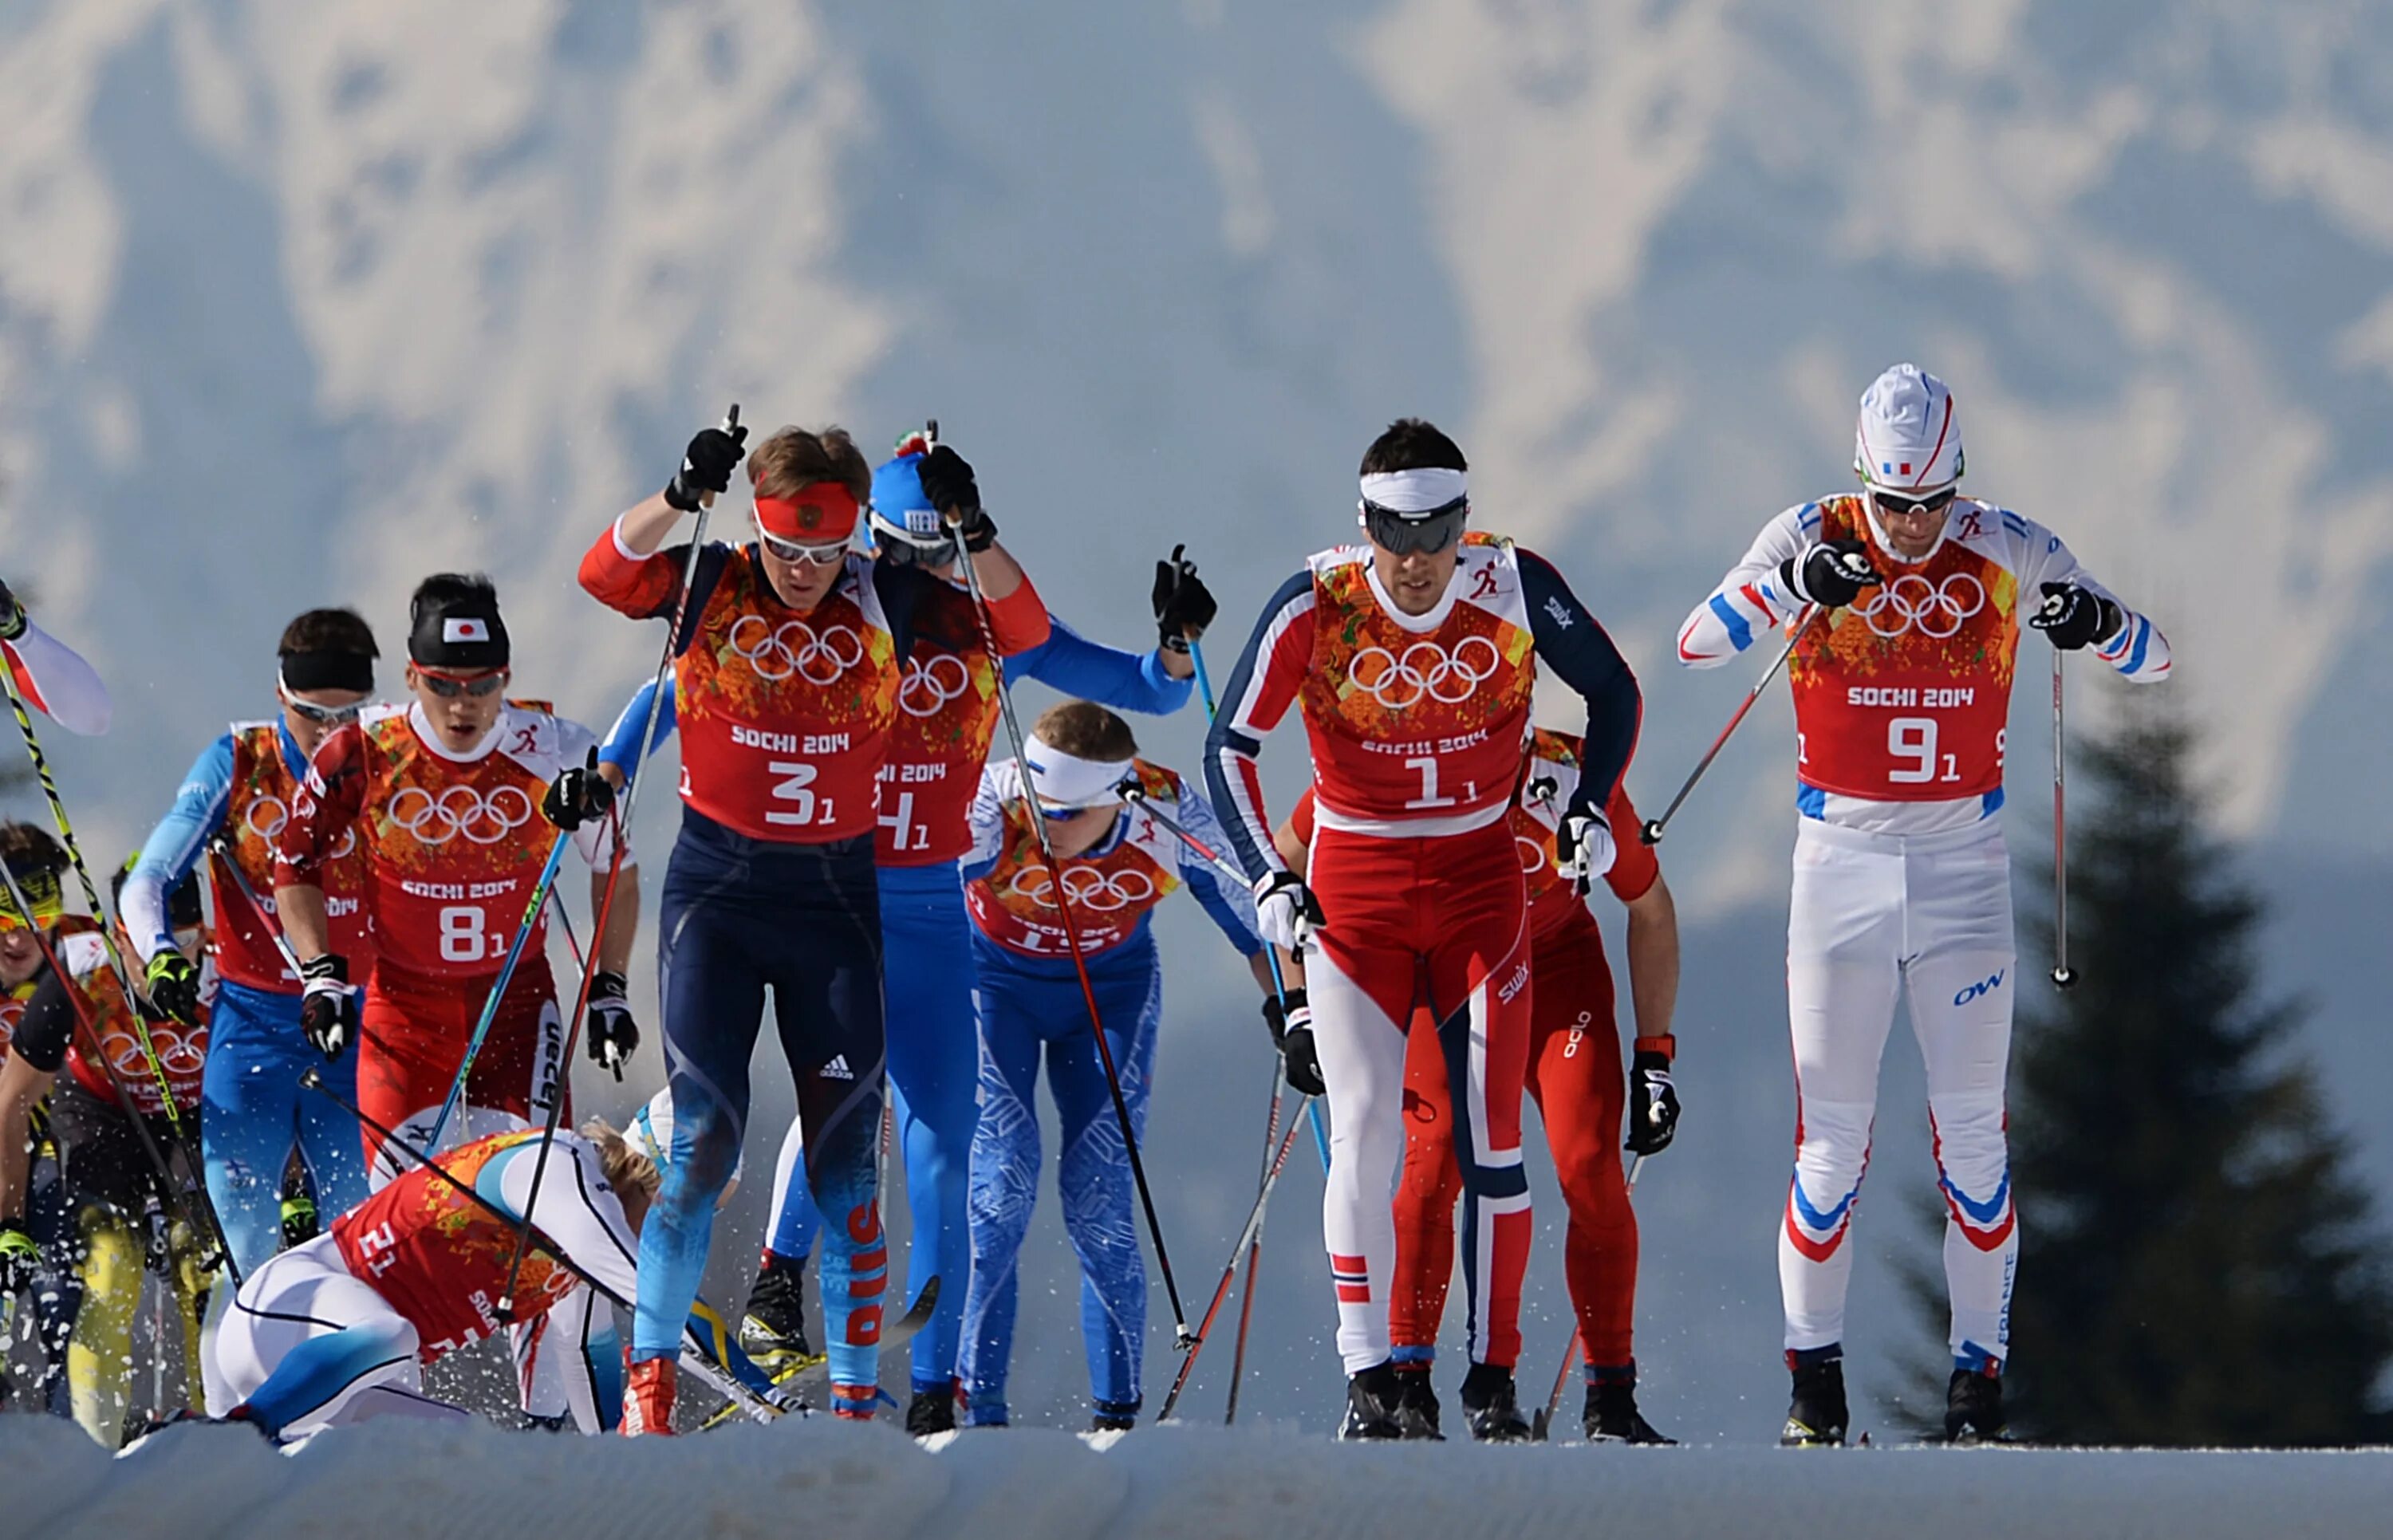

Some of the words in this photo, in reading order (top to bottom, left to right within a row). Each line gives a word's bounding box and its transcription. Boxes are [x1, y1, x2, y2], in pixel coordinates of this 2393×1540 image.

[1847, 687, 1916, 707] SOCHI
[1922, 687, 1974, 708] 2014
[731, 725, 796, 754] SOCHI
[802, 732, 850, 754] 2014
[1438, 727, 1489, 754] 2014
[901, 762, 946, 782] 2014
[401, 880, 463, 900] SOCHI
[469, 879, 517, 899] 2014
[1954, 967, 2005, 1006] OW
[819, 1069, 854, 1080] adidas
